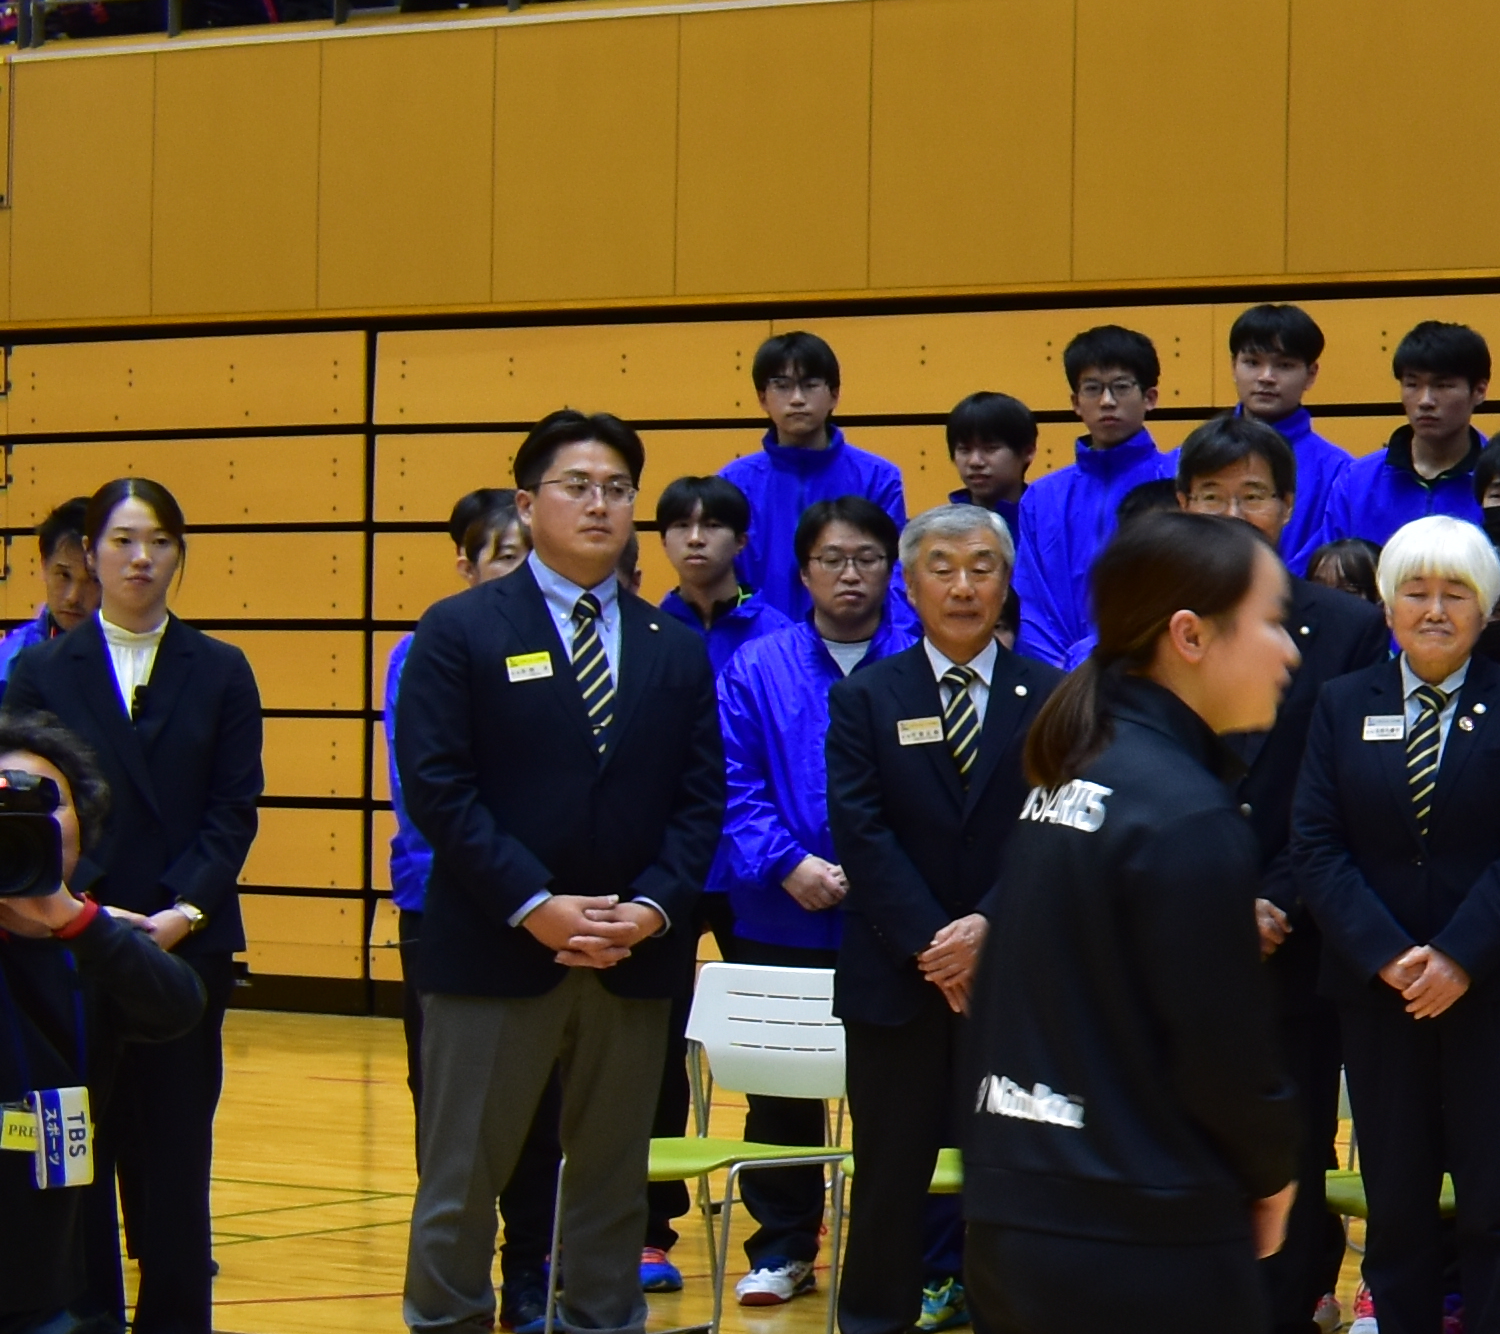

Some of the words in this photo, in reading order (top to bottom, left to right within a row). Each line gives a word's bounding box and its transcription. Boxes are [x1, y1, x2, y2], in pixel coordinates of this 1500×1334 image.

[45, 1108, 60, 1165] スポーツ
[66, 1110, 87, 1158] TBS
